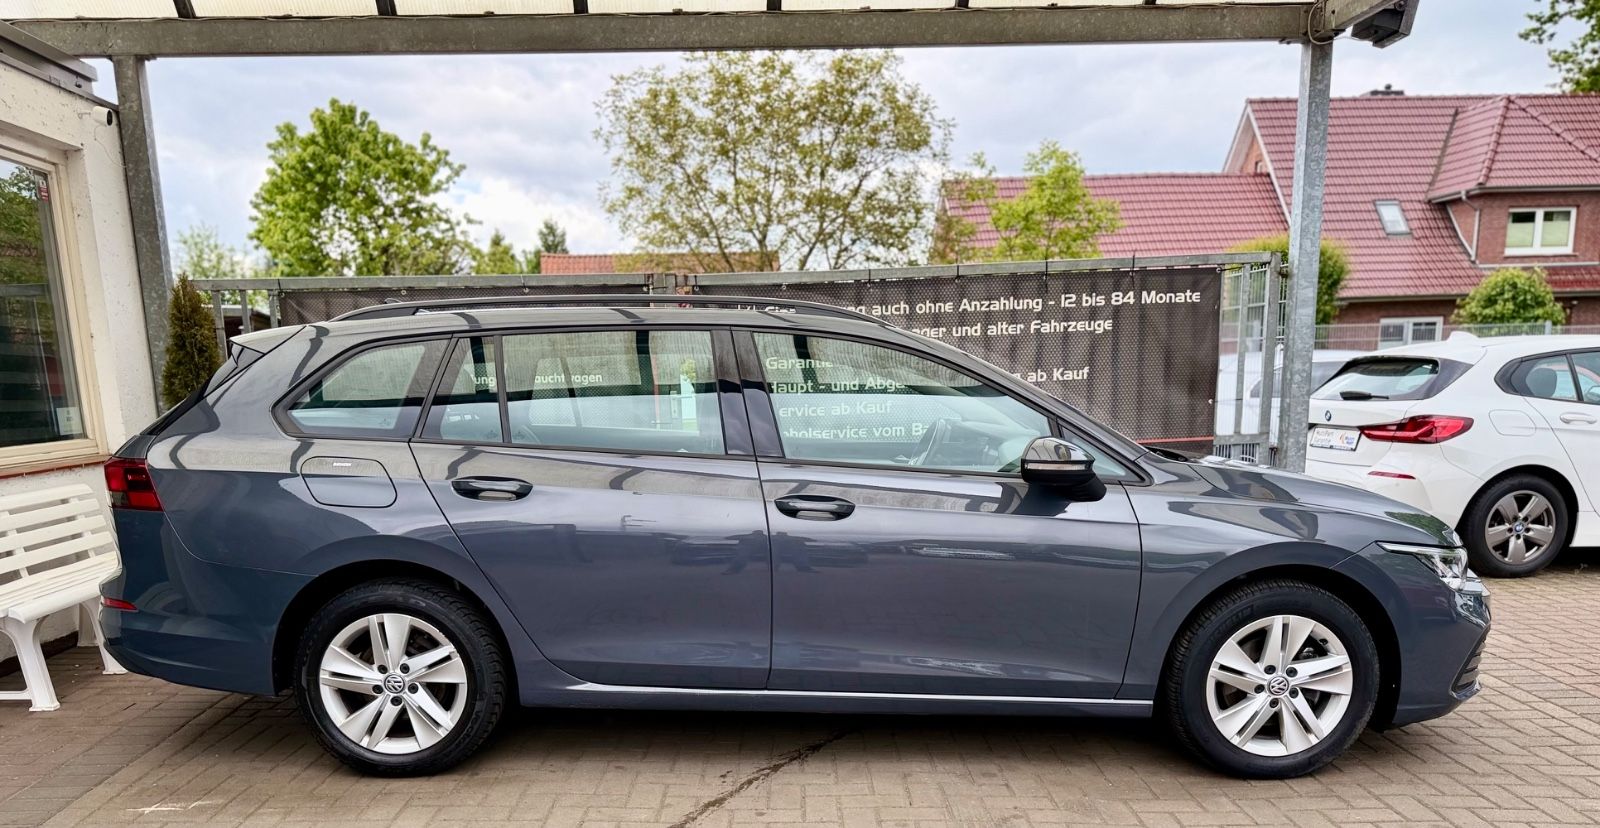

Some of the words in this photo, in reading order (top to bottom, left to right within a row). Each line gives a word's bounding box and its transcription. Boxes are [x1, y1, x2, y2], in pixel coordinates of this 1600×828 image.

[872, 302, 909, 316] auch
[916, 300, 953, 315] ohne
[959, 295, 1043, 312] Anzahlung
[1082, 292, 1105, 307] bis
[1111, 291, 1135, 306] 84
[1141, 289, 1201, 304] Monate
[952, 322, 981, 338] und
[987, 321, 1025, 337] alter
[1030, 318, 1113, 335] Fahrzeuge
[831, 377, 860, 392] und
[1027, 369, 1047, 382] ab
[1052, 366, 1090, 381] Kauf
[778, 404, 826, 417] ervice
[831, 402, 850, 416] ab
[856, 400, 892, 414] Kauf
[872, 426, 905, 437] vom
